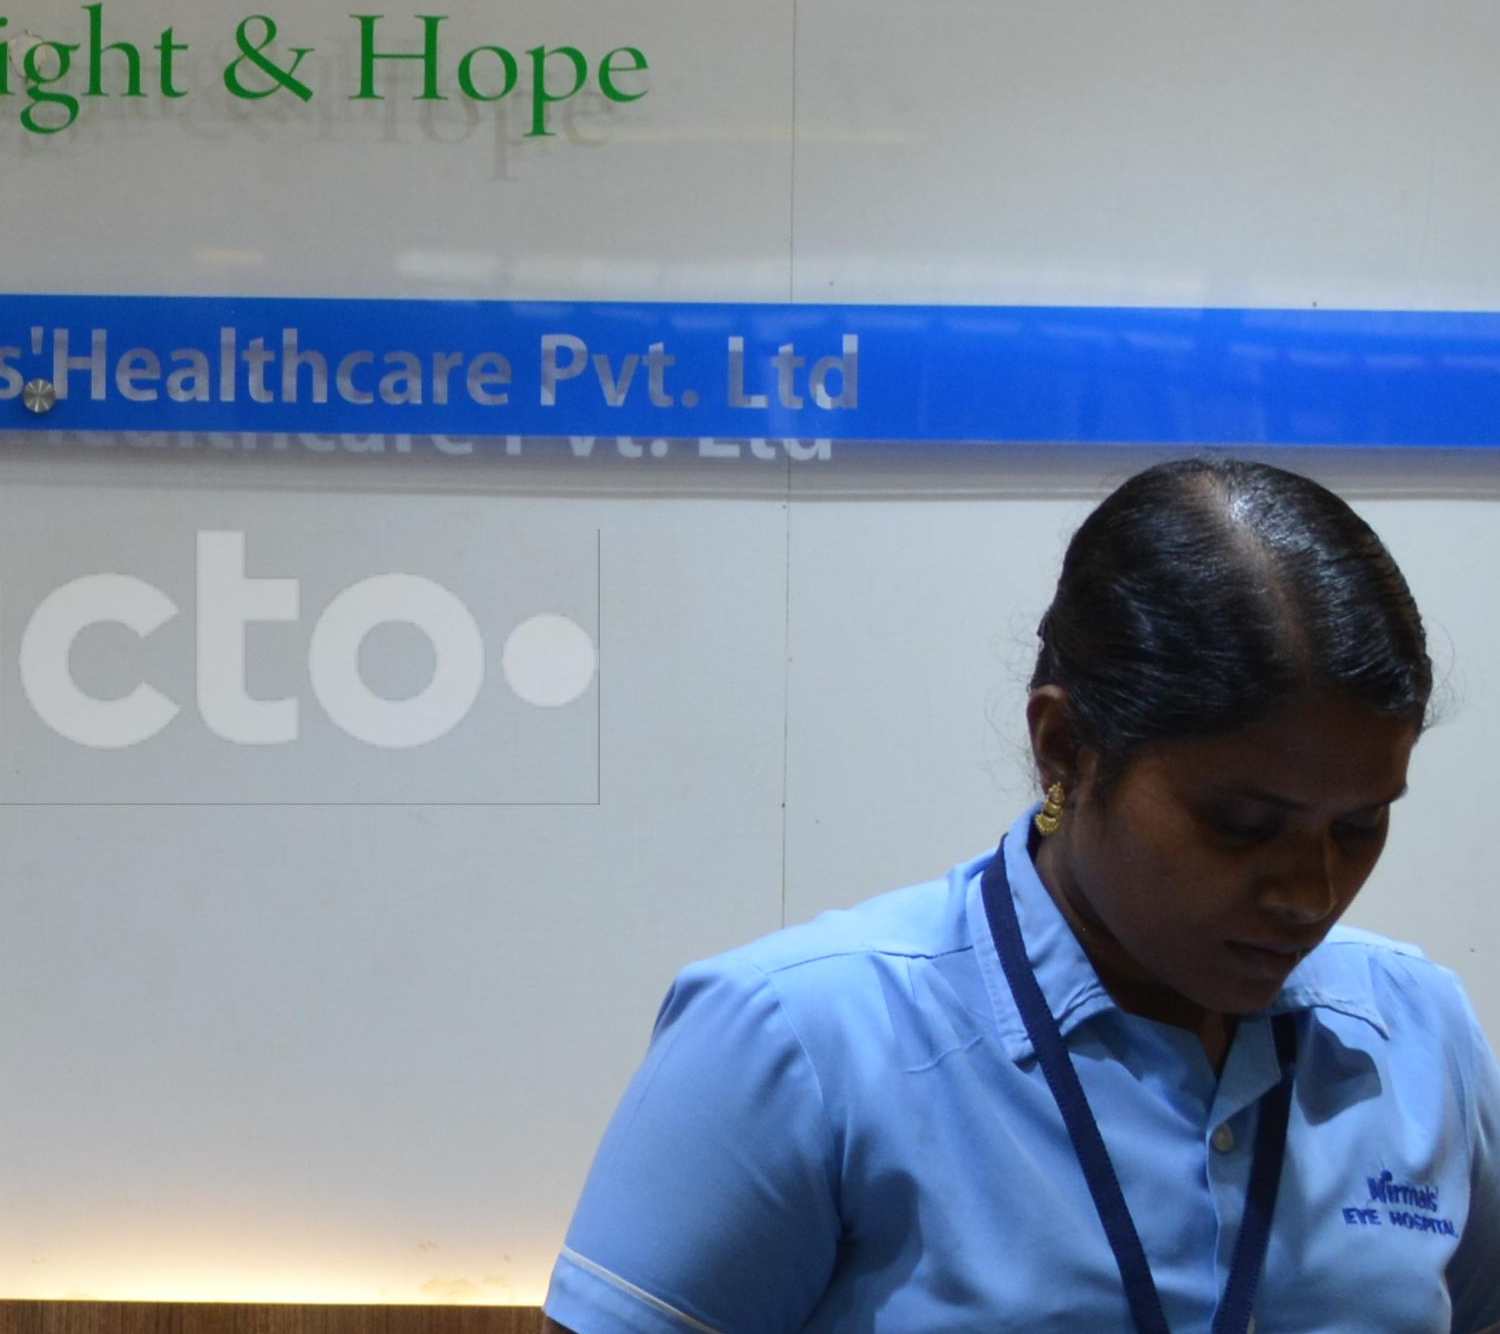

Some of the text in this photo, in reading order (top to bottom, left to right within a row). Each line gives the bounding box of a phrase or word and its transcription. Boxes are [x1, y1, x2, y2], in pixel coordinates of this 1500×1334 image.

[221, 14, 315, 103] &
[347, 13, 651, 137] Hope
[539, 332, 700, 408] Pvt.
[727, 333, 860, 410] Ltd
[1342, 1207, 1382, 1226] EYE
